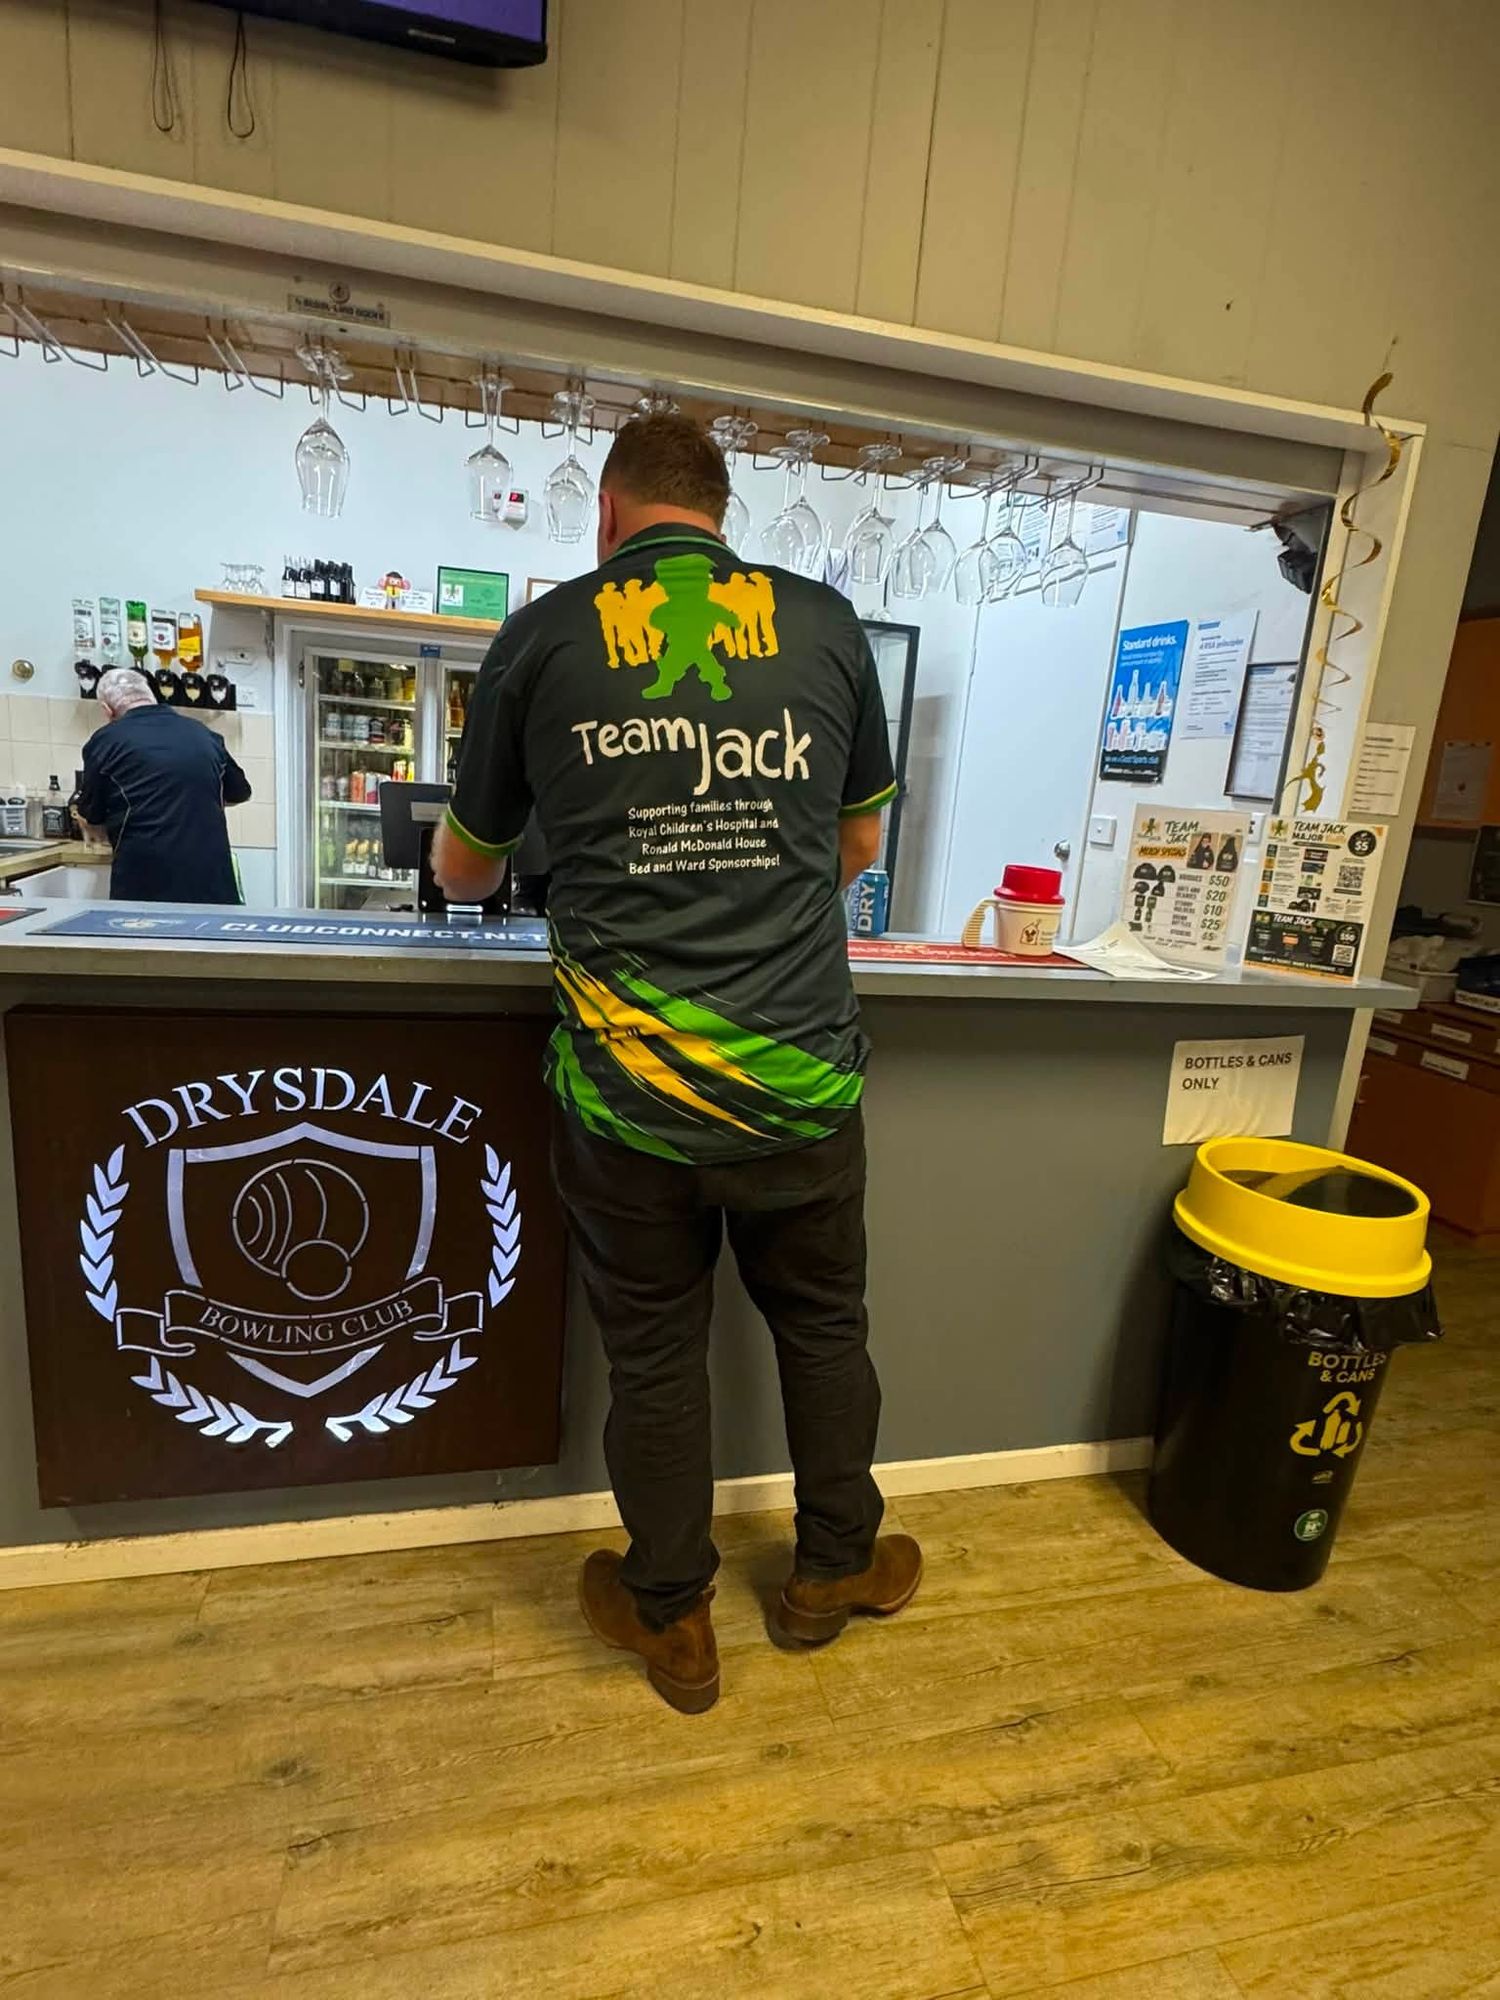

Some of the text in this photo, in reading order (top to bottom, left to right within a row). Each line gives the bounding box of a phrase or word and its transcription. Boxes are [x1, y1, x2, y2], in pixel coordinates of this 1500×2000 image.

[1122, 637, 1152, 651] Standard
[628, 798, 774, 821] Supporting families through
[628, 818, 779, 839] Royal Children's Hospital and
[1165, 820, 1199, 834] TEAM
[1294, 821, 1348, 835] TEAM JACK
[642, 837, 767, 855] Ronald McDonald House
[629, 854, 780, 875] Bed and Ward Sponsorships!
[1209, 874, 1230, 887] $50
[1206, 889, 1227, 902] $20
[857, 881, 875, 931] DRY
[1203, 904, 1223, 917] $10
[1200, 918, 1221, 930] $25
[1273, 913, 1294, 923] TEAM
[1184, 1052, 1292, 1069] BOTTLES & CANS
[1182, 1078, 1219, 1090] ONLY
[121, 1067, 483, 1148] DRYSDALE
[200, 1300, 414, 1345] BOWLING CLUB
[1320, 1368, 1375, 1383] & CANS
